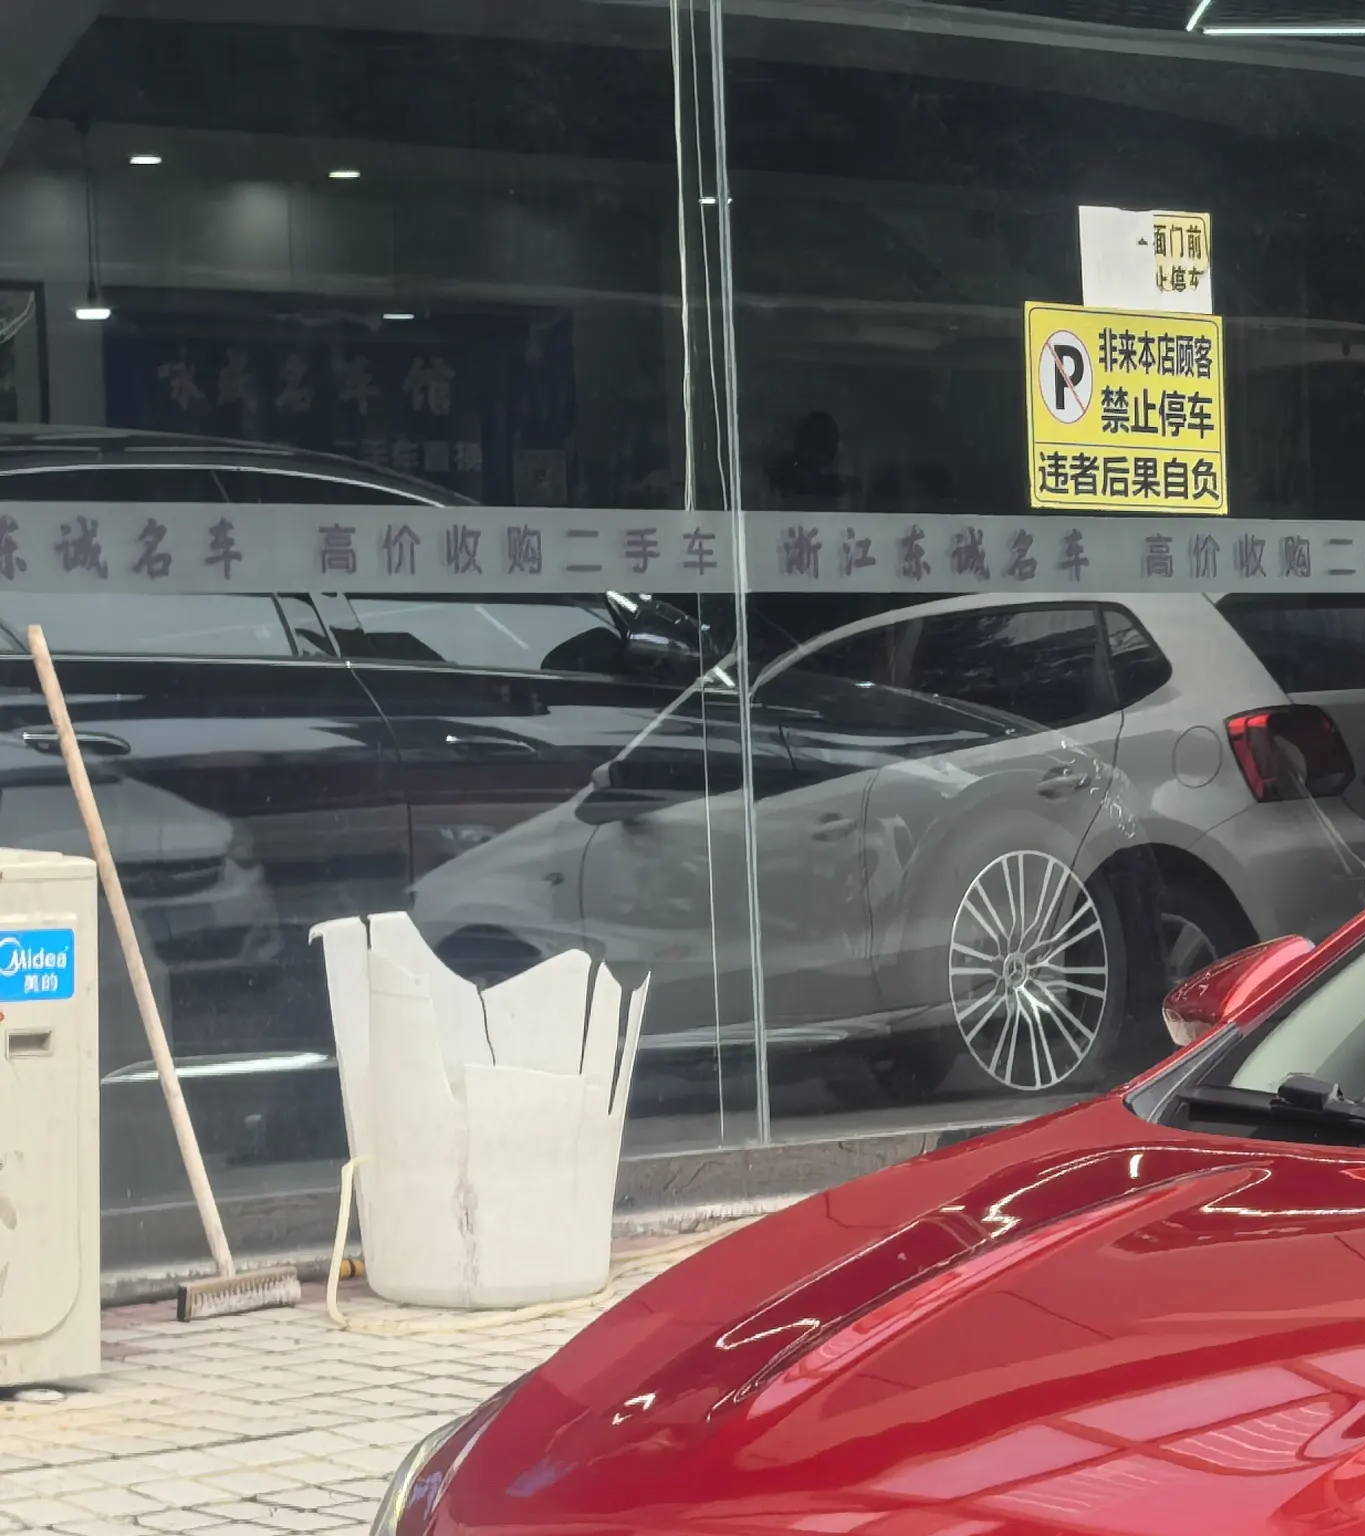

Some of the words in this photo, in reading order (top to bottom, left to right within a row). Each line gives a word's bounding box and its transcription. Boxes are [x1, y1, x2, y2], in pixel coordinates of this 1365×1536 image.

[1098, 327, 1213, 379] 非来本店顾客
[1101, 386, 1215, 439] 禁止停车
[1038, 451, 1221, 500] 违者后果自负
[318, 522, 718, 578] 高价收购二手车
[784, 526, 1090, 583] 浙江东诚名车
[8, 943, 68, 973] Midea
